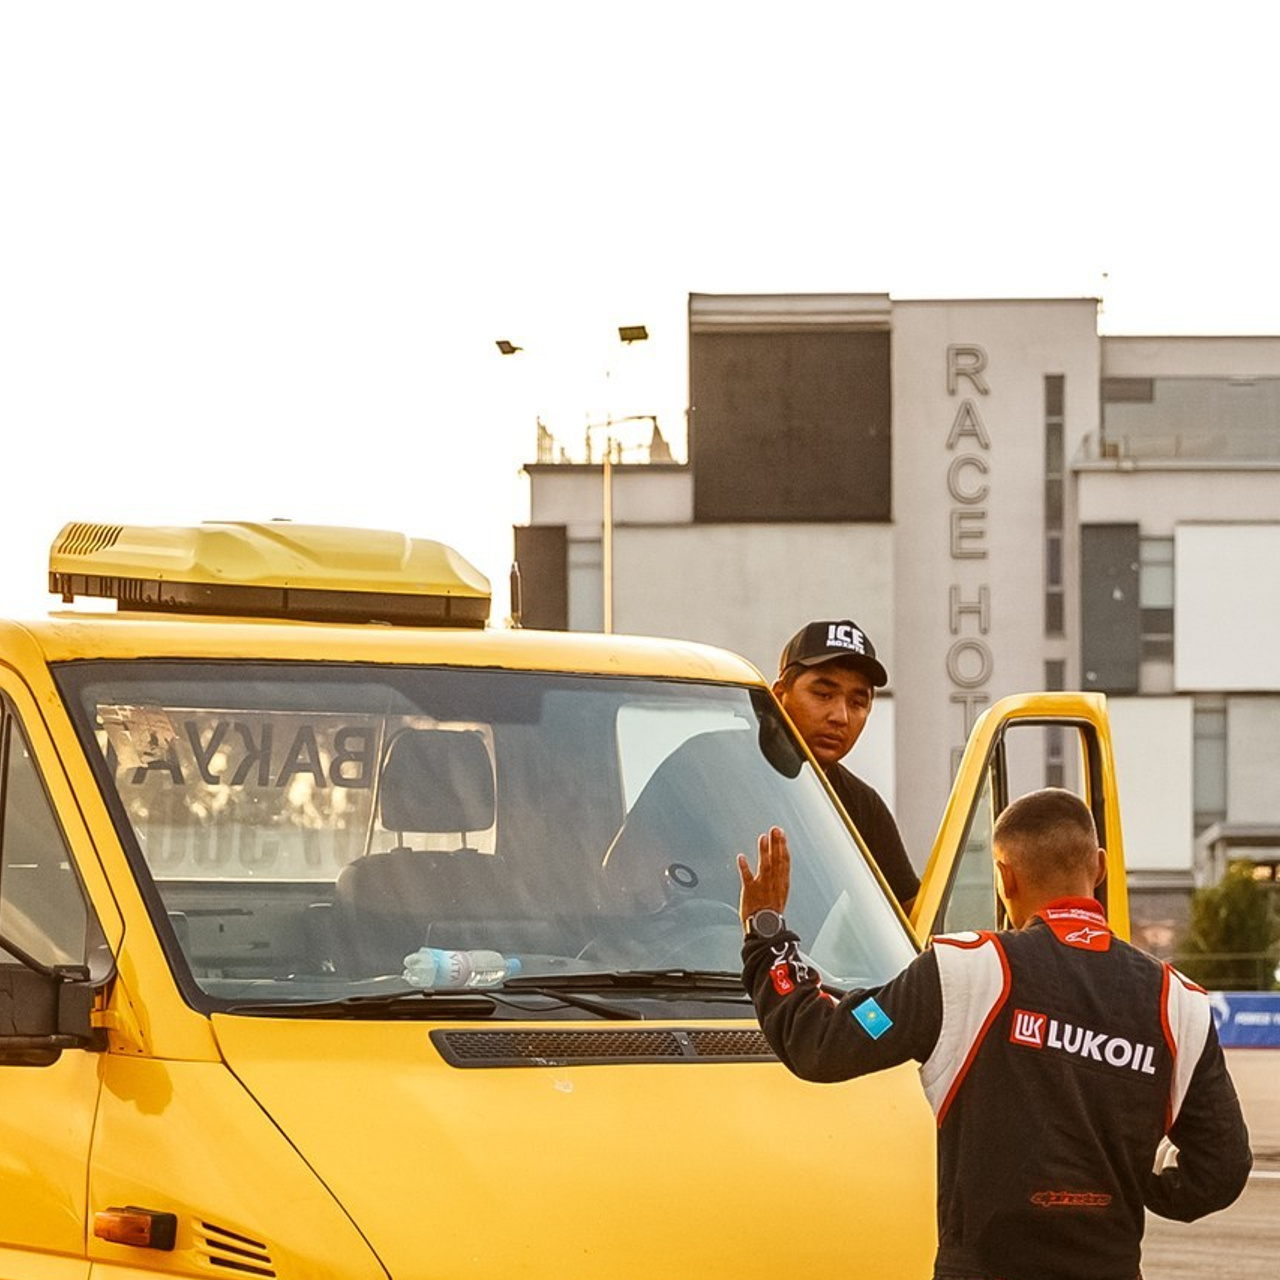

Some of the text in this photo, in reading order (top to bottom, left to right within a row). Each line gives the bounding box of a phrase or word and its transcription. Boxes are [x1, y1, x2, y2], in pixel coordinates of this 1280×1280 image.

[945, 343, 994, 788] RACE HOT
[827, 624, 864, 649] ICE
[1047, 1019, 1157, 1075] LUKOIL
